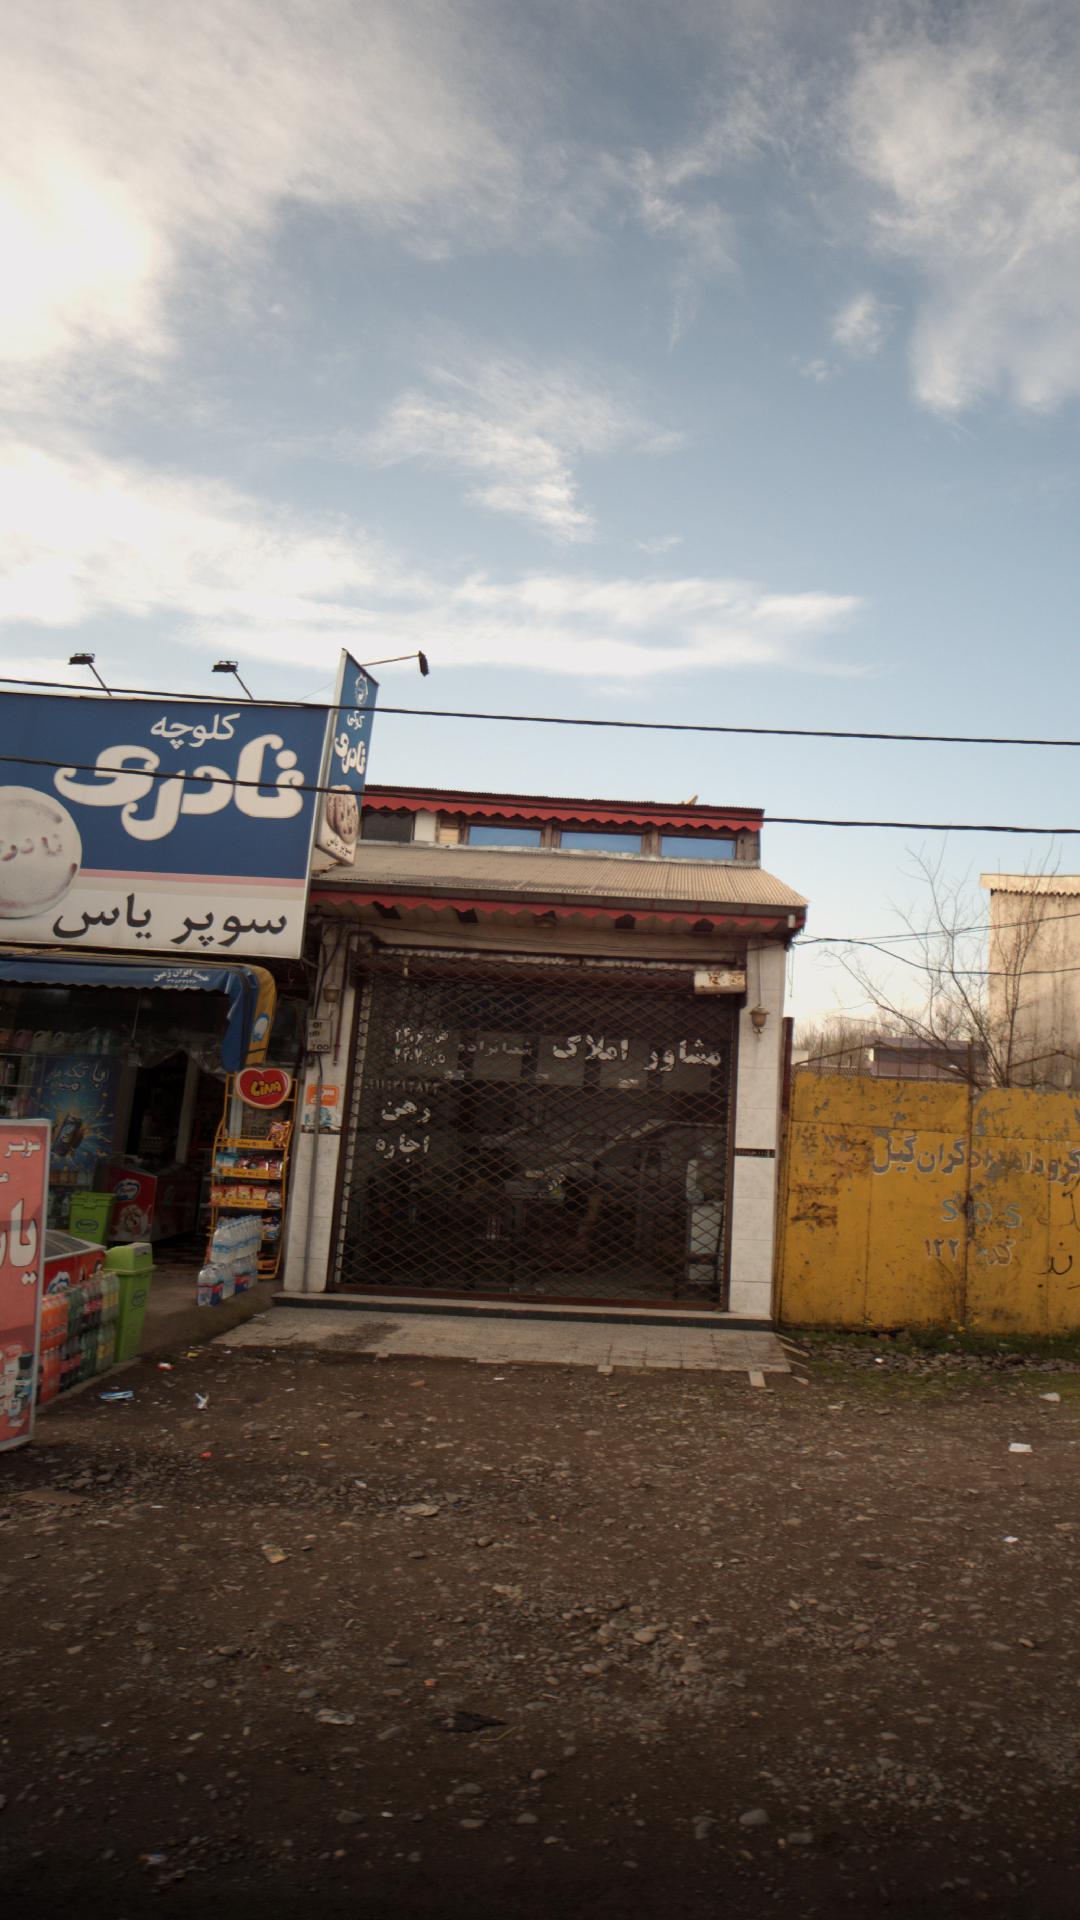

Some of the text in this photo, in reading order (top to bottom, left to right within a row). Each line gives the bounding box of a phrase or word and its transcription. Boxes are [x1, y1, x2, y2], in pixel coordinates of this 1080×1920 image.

[150, 712, 241, 750] کلوچه
[334, 731, 367, 775] نادری
[54, 733, 305, 841] نادری
[53, 892, 288, 948] سوپر یاس
[552, 1034, 629, 1061] املاک
[643, 1037, 721, 1072] مشاور
[381, 1099, 431, 1123] رهن
[375, 1133, 430, 1164] اجاره
